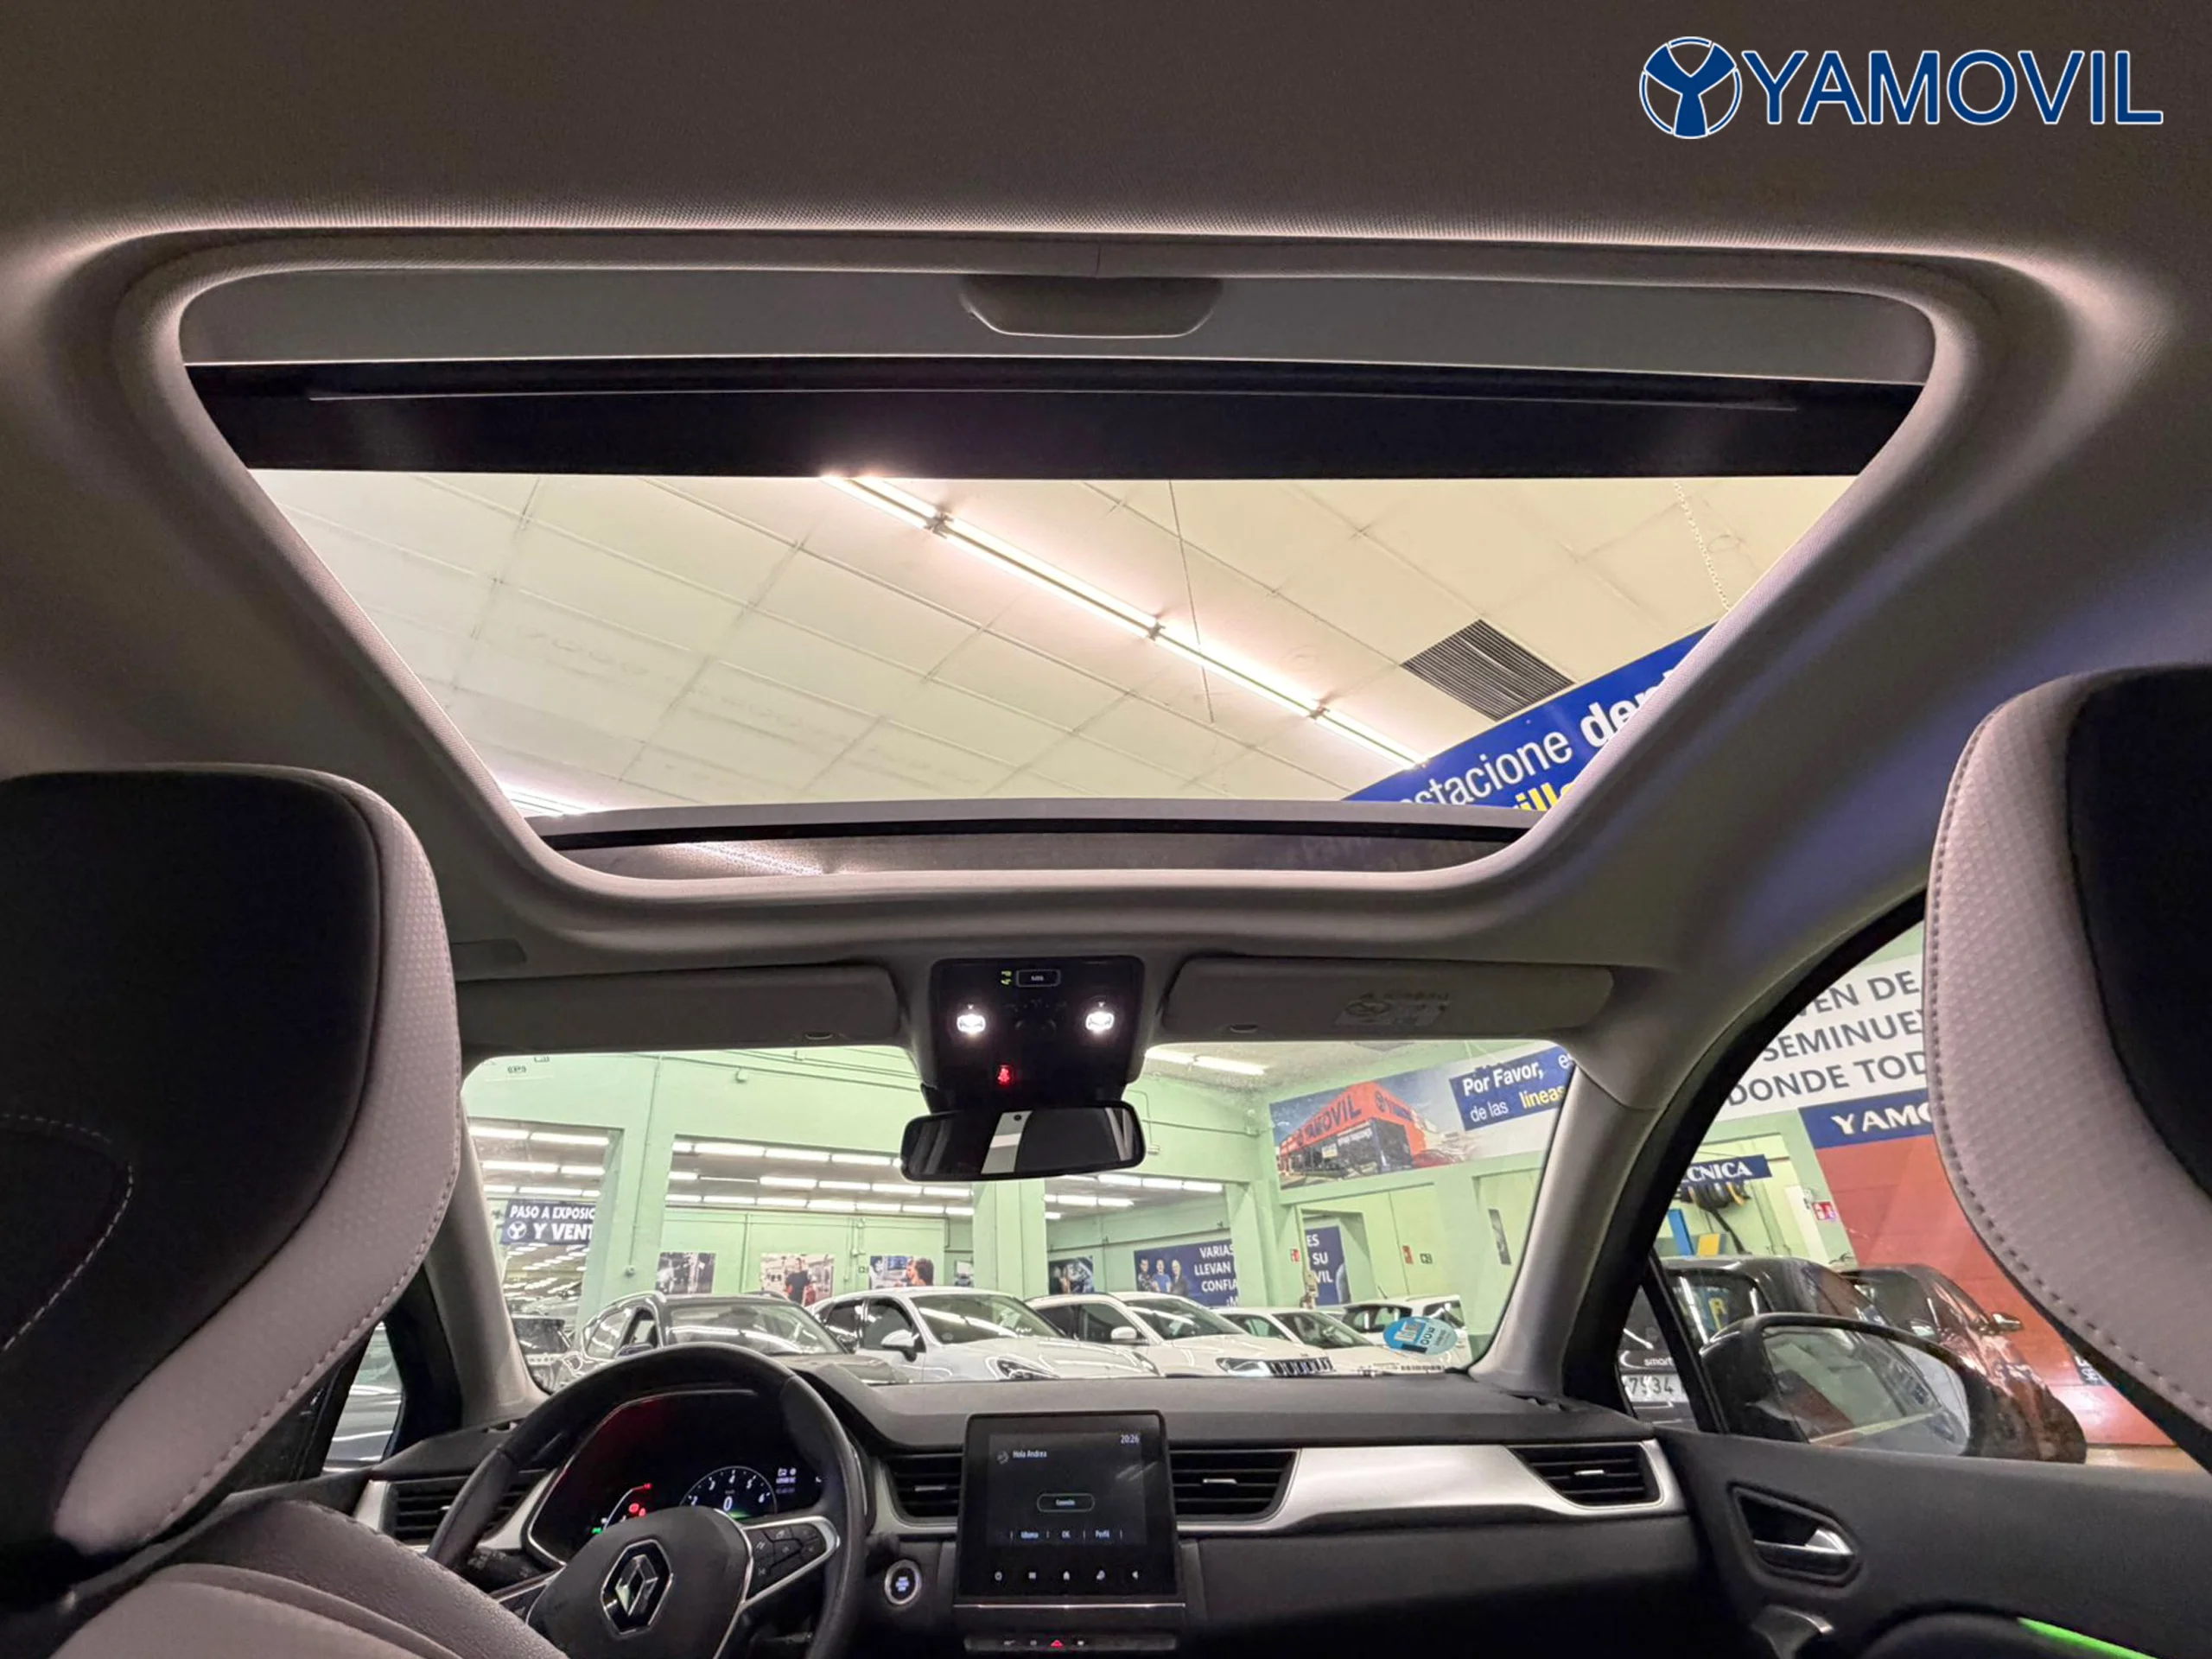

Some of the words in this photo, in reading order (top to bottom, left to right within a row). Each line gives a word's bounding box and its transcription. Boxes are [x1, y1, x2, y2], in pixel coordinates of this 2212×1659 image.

[1398, 730, 1573, 805] stacione
[1798, 983, 1859, 1016] EN
[1867, 970, 1920, 1001] DE
[1763, 1009, 1923, 1062] SEMINUE
[1463, 1076, 1491, 1096] Por
[1492, 1061, 1544, 1088] Favor,
[1727, 1065, 1850, 1106] DONDE
[1470, 1105, 1487, 1122] de
[1488, 1101, 1509, 1117] las
[1681, 1161, 1753, 1183] CNICA
[510, 1205, 540, 1218] PASO
[541, 1206, 550, 1219] A
[532, 1223, 547, 1240] Y
[1199, 1244, 1235, 1259] VARIAS
[1312, 1252, 1329, 1265] SU
[1194, 1262, 1231, 1276] LLEVAN
[1643, 1357, 1674, 1366] smart
[1120, 1434, 1140, 1444] 20:26
[722, 1496, 734, 1511] 0
